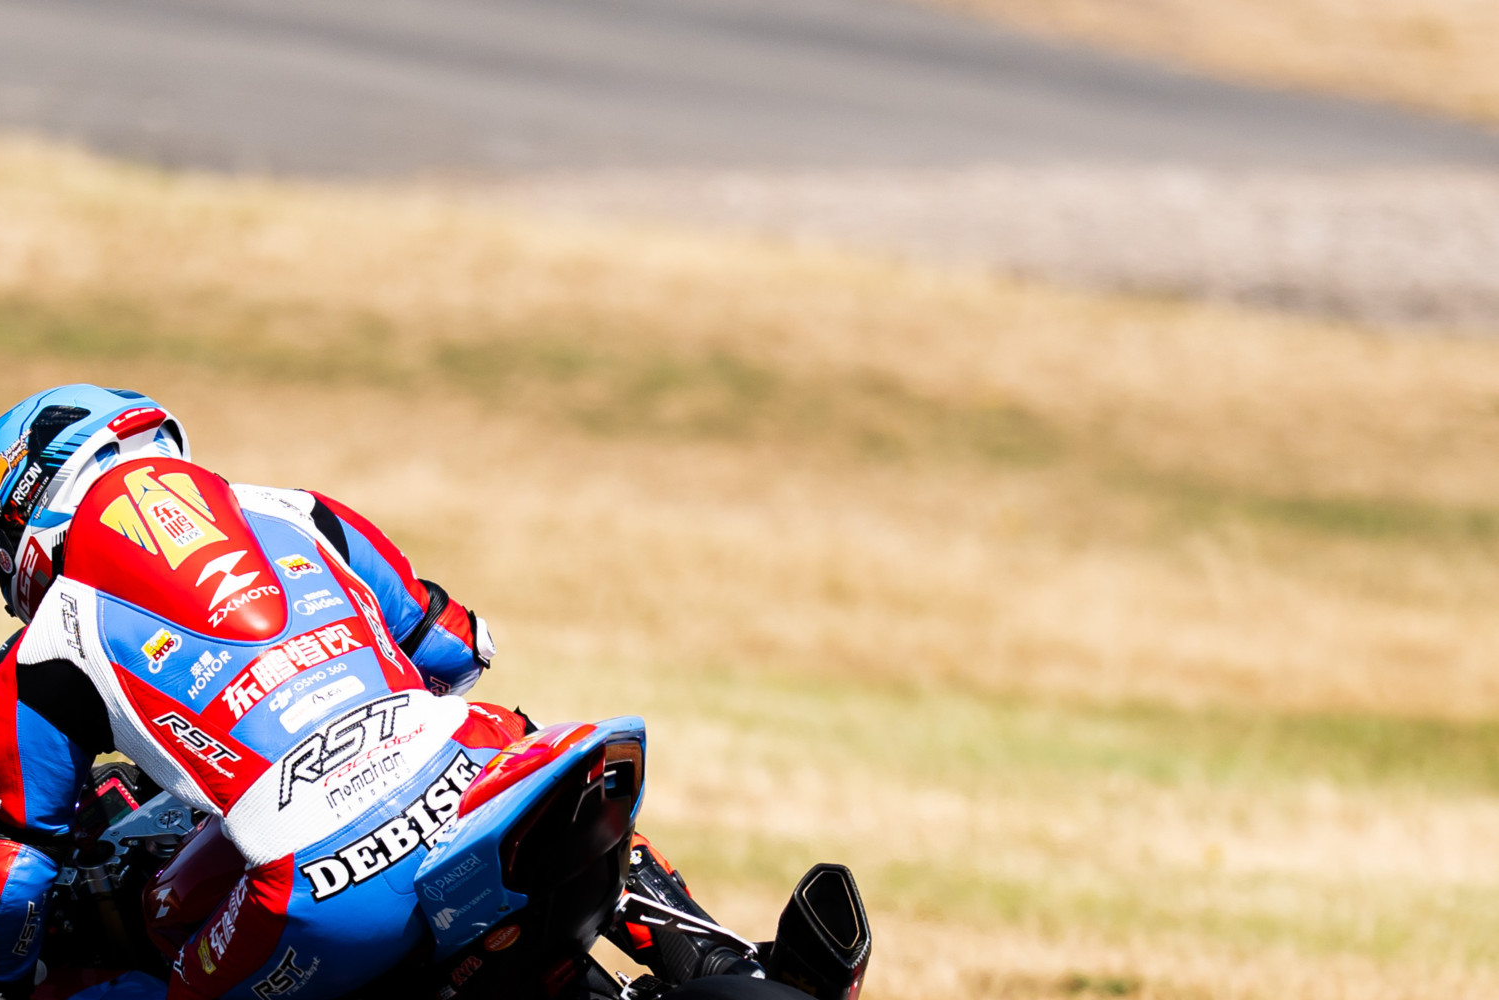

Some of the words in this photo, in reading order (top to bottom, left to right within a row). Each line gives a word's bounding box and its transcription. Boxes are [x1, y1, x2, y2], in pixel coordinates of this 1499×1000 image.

[13, 462, 43, 505] RISON
[19, 543, 40, 614] LS2
[208, 585, 280, 628] ZXMOTO
[187, 650, 232, 700] HONOR
[221, 623, 363, 721] 东鹏特饮
[293, 671, 327, 692] OSMO
[326, 662, 348, 678] 360
[152, 711, 242, 763] RST
[278, 693, 410, 812] RST
[299, 750, 483, 902] DEBISE
[12, 899, 35, 957] RST
